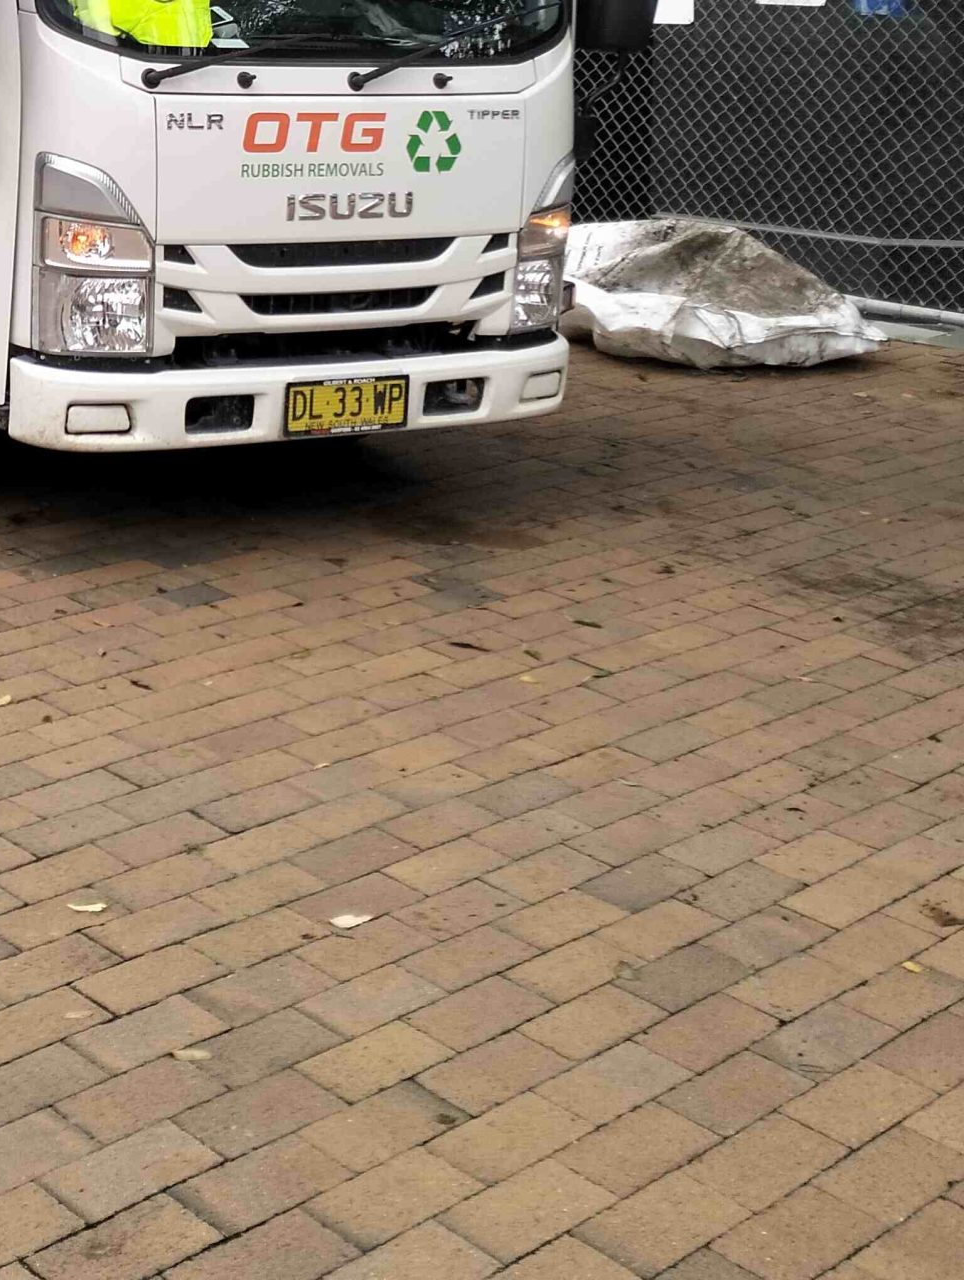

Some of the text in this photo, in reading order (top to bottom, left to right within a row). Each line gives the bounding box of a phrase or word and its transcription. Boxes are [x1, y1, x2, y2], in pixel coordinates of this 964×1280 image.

[166, 113, 224, 131] NLR
[467, 109, 520, 120] TIPPER
[242, 112, 386, 153] OTG
[241, 162, 384, 178] RUBBISH REMOVALS
[286, 191, 413, 221] ISUZU
